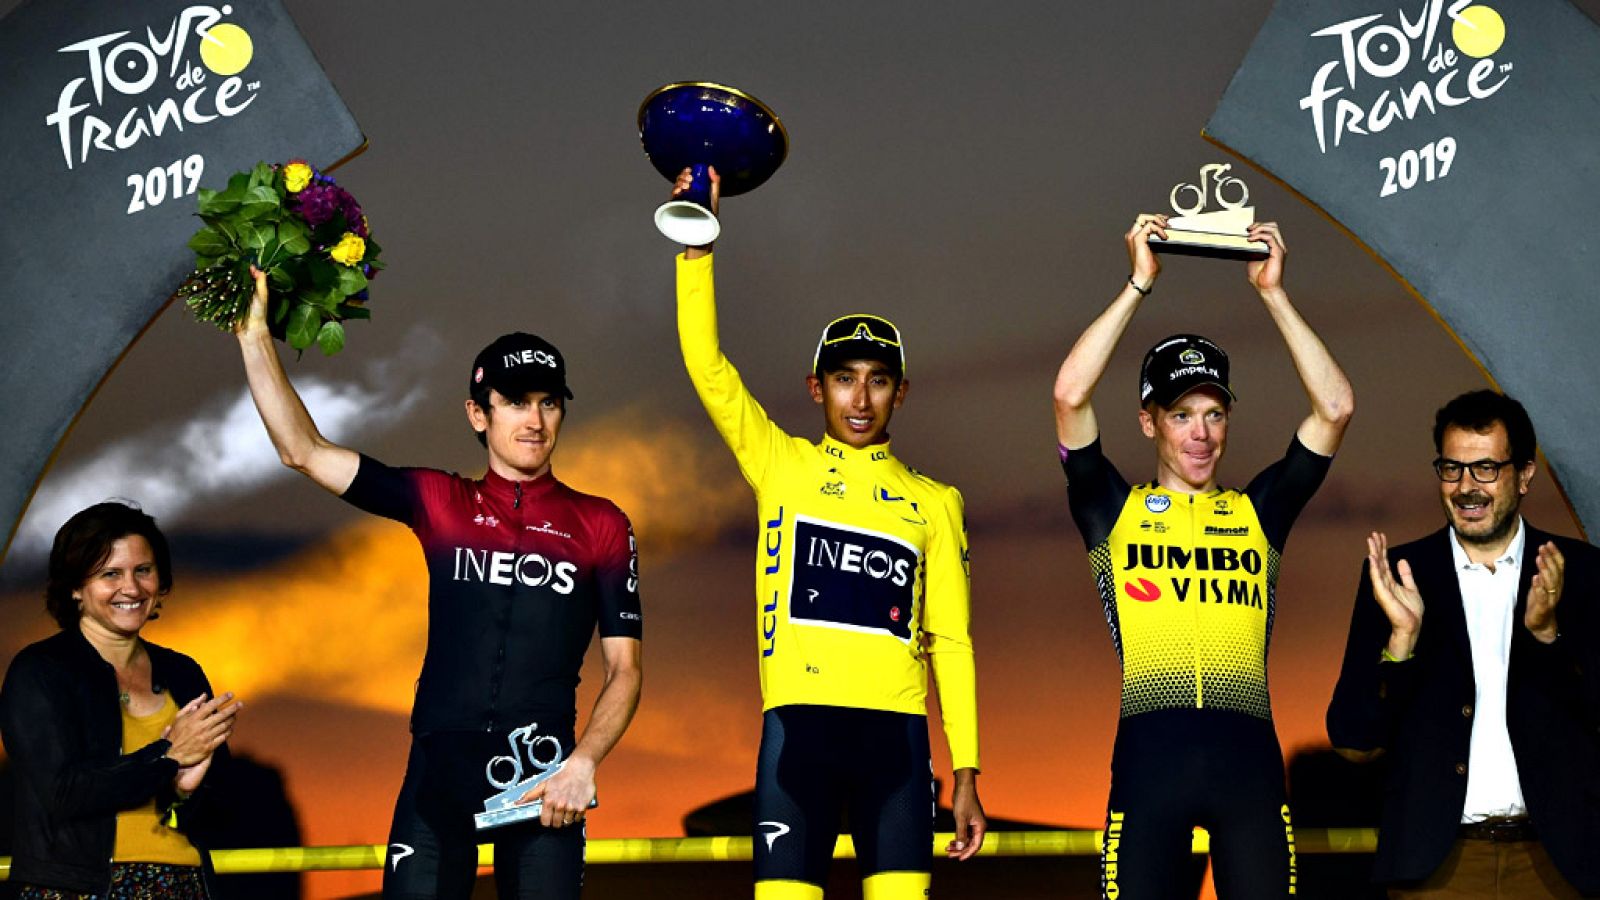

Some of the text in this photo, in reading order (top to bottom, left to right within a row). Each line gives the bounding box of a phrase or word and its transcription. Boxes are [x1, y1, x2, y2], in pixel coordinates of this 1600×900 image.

[1427, 42, 1459, 74] de
[175, 60, 206, 91] de
[126, 153, 204, 215] 2019
[1379, 136, 1457, 198] 2019
[503, 349, 557, 369] INEOS
[825, 444, 846, 460] LCL
[870, 451, 889, 462] LCL
[453, 547, 578, 595] INEOS
[807, 536, 910, 587] INEOS
[1122, 543, 1262, 576] JUMBO
[762, 505, 784, 658] LCL LCL
[1170, 577, 1264, 611] VISMA
[1105, 809, 1125, 900] JUMBO
